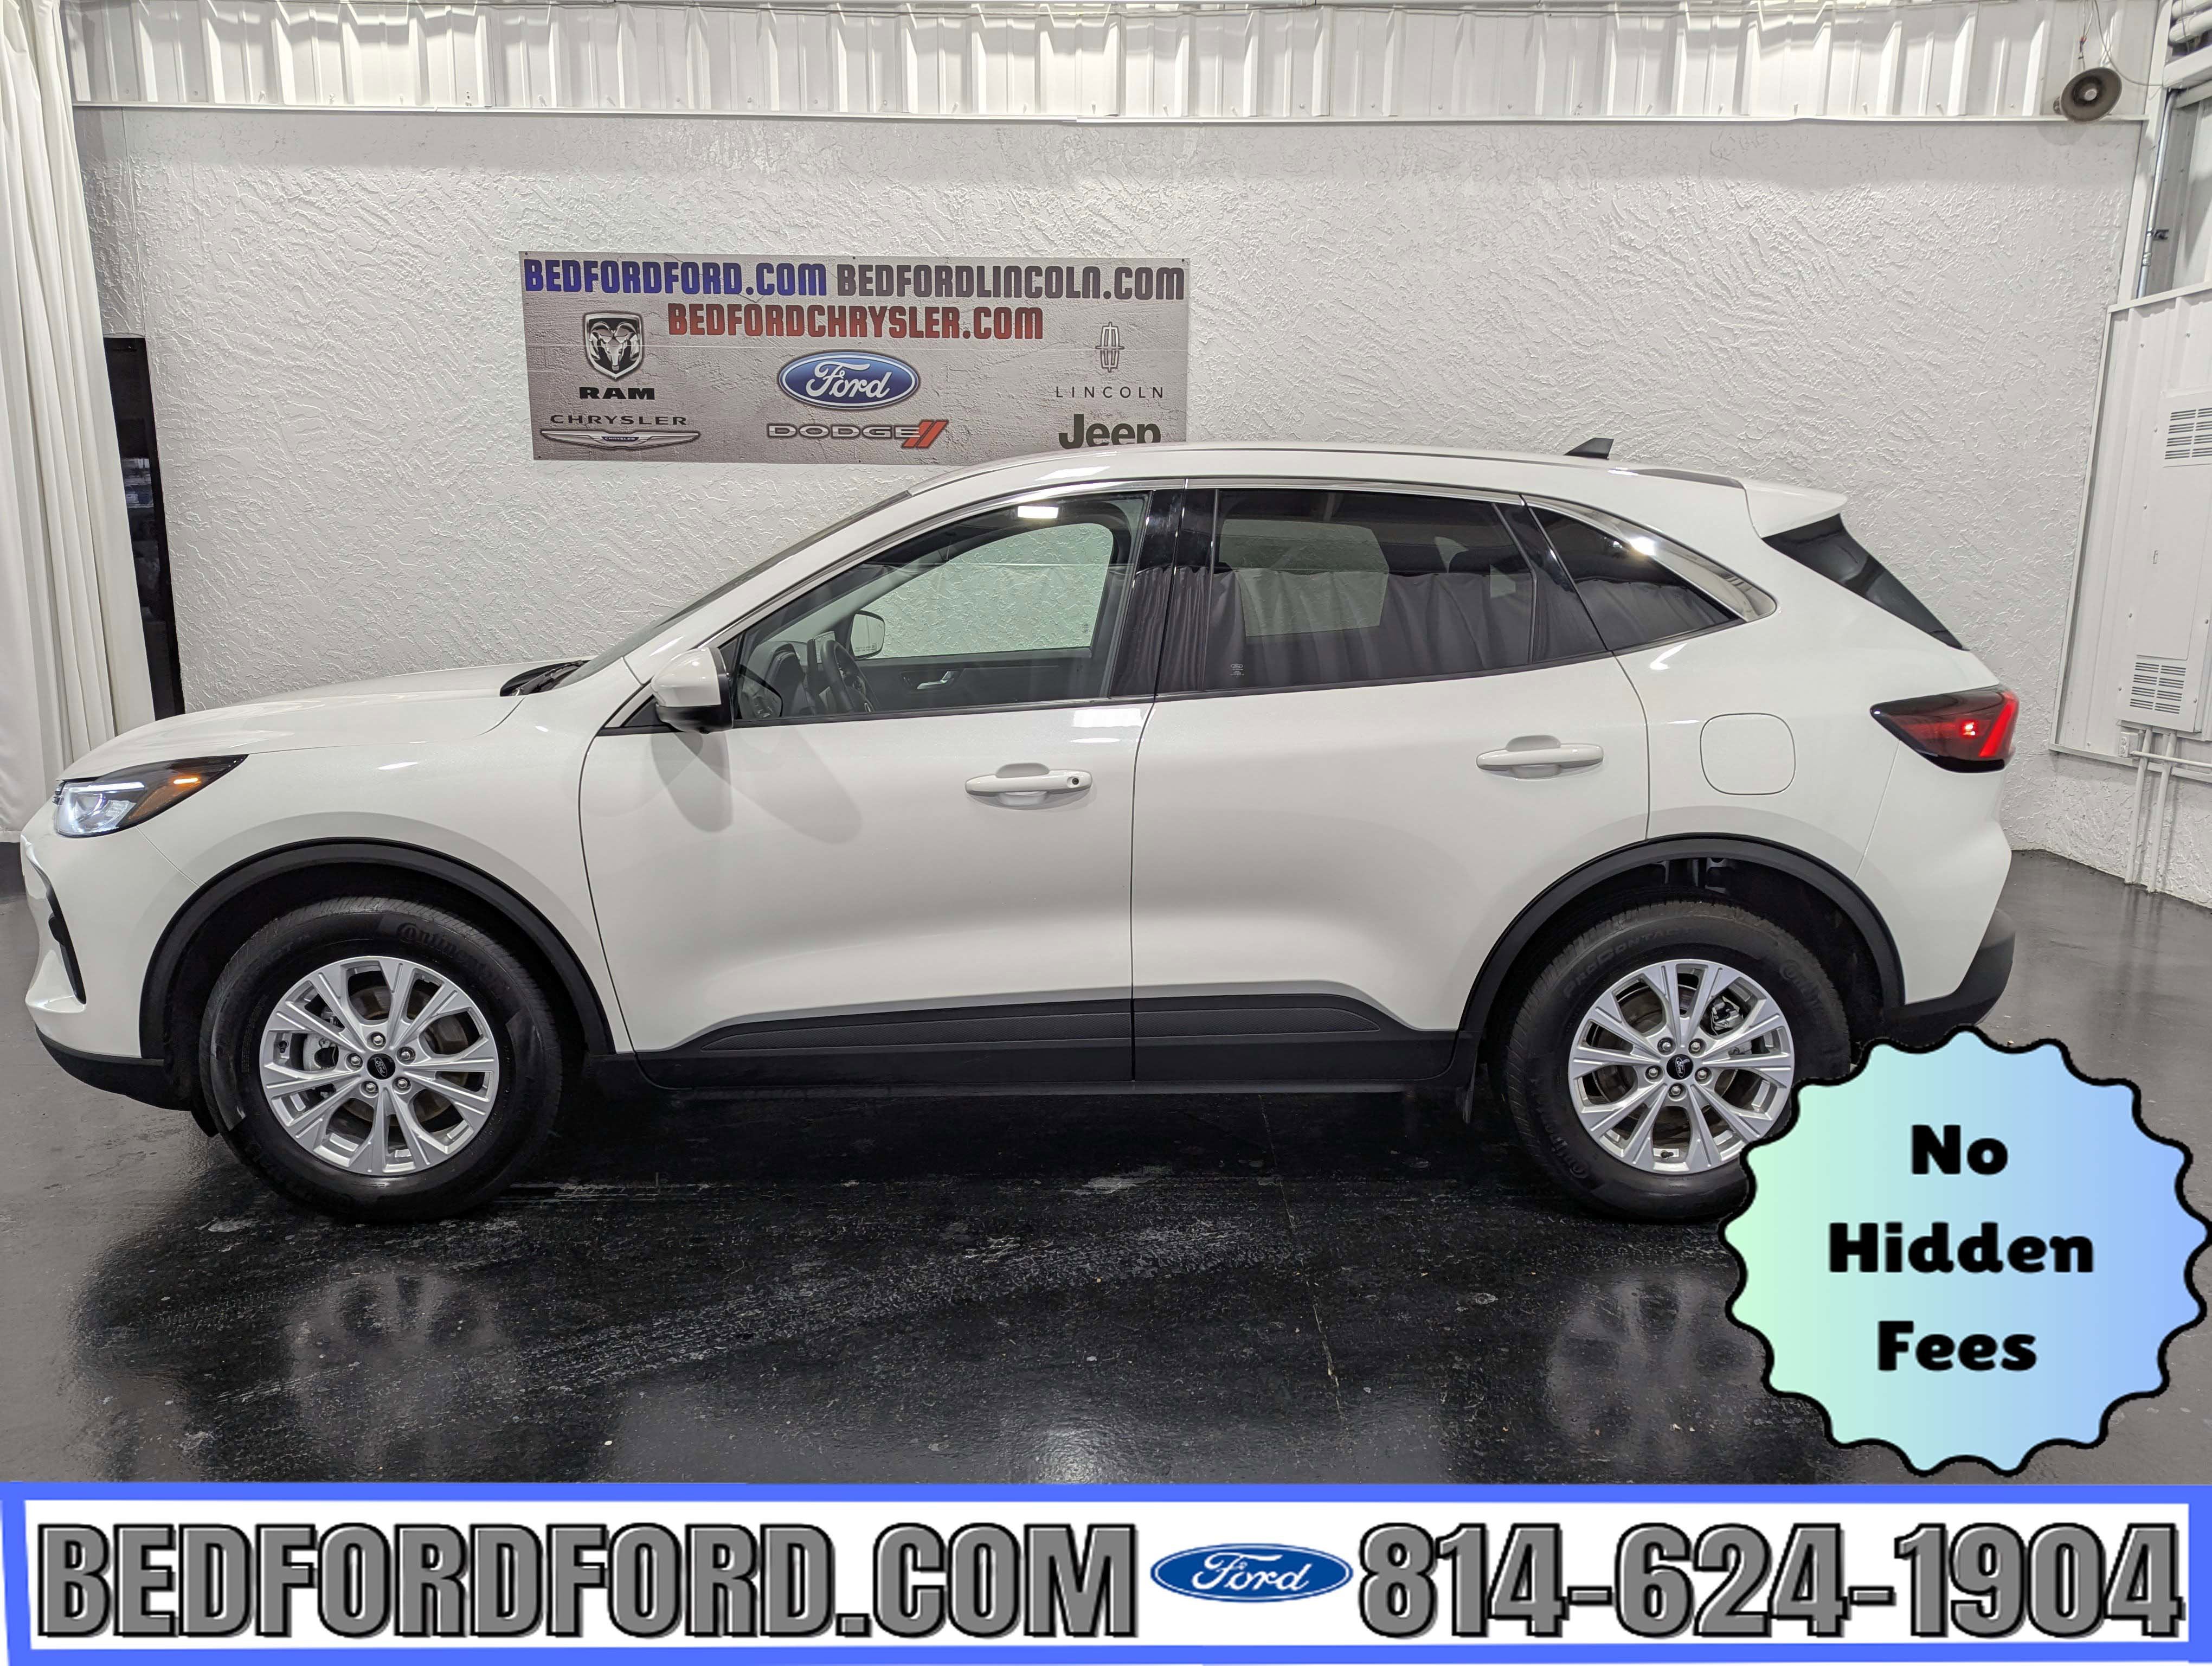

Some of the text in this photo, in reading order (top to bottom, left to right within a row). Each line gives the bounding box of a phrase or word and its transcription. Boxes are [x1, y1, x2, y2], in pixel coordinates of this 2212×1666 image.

[524, 259, 1185, 301] BEDFORDFORD.COM BEDFORDLINCOLN.COM
[668, 303, 1043, 339] BEDFORDCHRYSLER.COM
[806, 361, 891, 398] Ford
[579, 387, 655, 400] RAM
[1056, 386, 1163, 399] LINCOLN
[550, 414, 687, 425] CHRYSLER
[768, 424, 921, 439] DODGE
